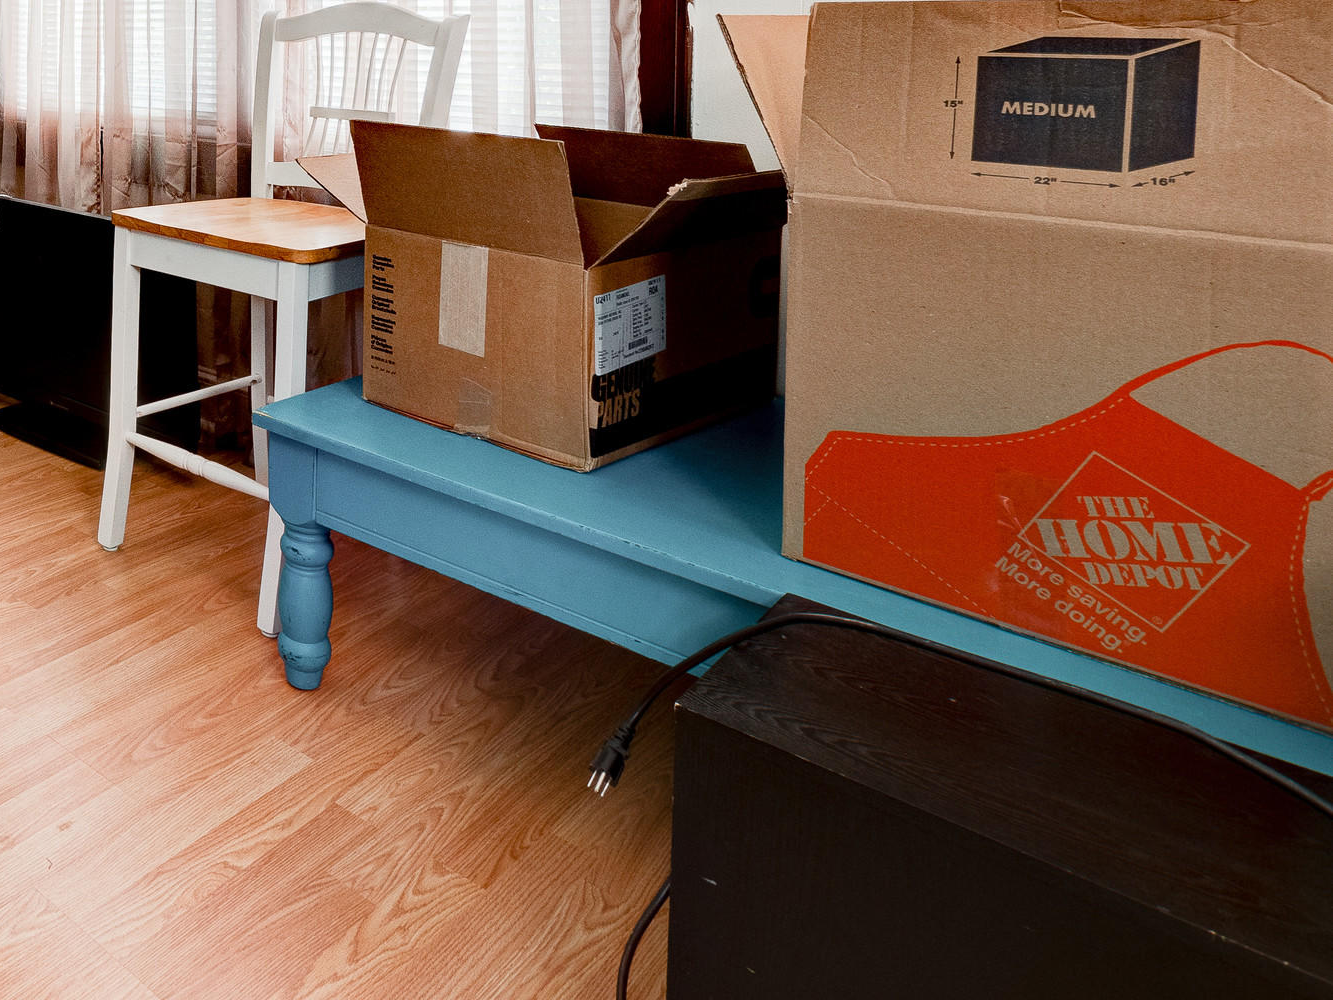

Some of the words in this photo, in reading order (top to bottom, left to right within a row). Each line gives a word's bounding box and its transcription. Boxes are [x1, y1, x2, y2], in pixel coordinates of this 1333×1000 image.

[943, 100, 963, 108] 15"
[1001, 101, 1096, 119] MEDIUM
[1034, 176, 1057, 186] 22"
[1150, 176, 1176, 186] 16"
[589, 388, 641, 429] PARTS
[1076, 496, 1155, 518] THE
[1034, 518, 1234, 565] HOME
[1082, 562, 1203, 590] DEPOT
[995, 556, 1052, 600] More
[1054, 600, 1123, 653] doing.
[1007, 541, 1066, 586] More
[1067, 584, 1148, 646] saving.
